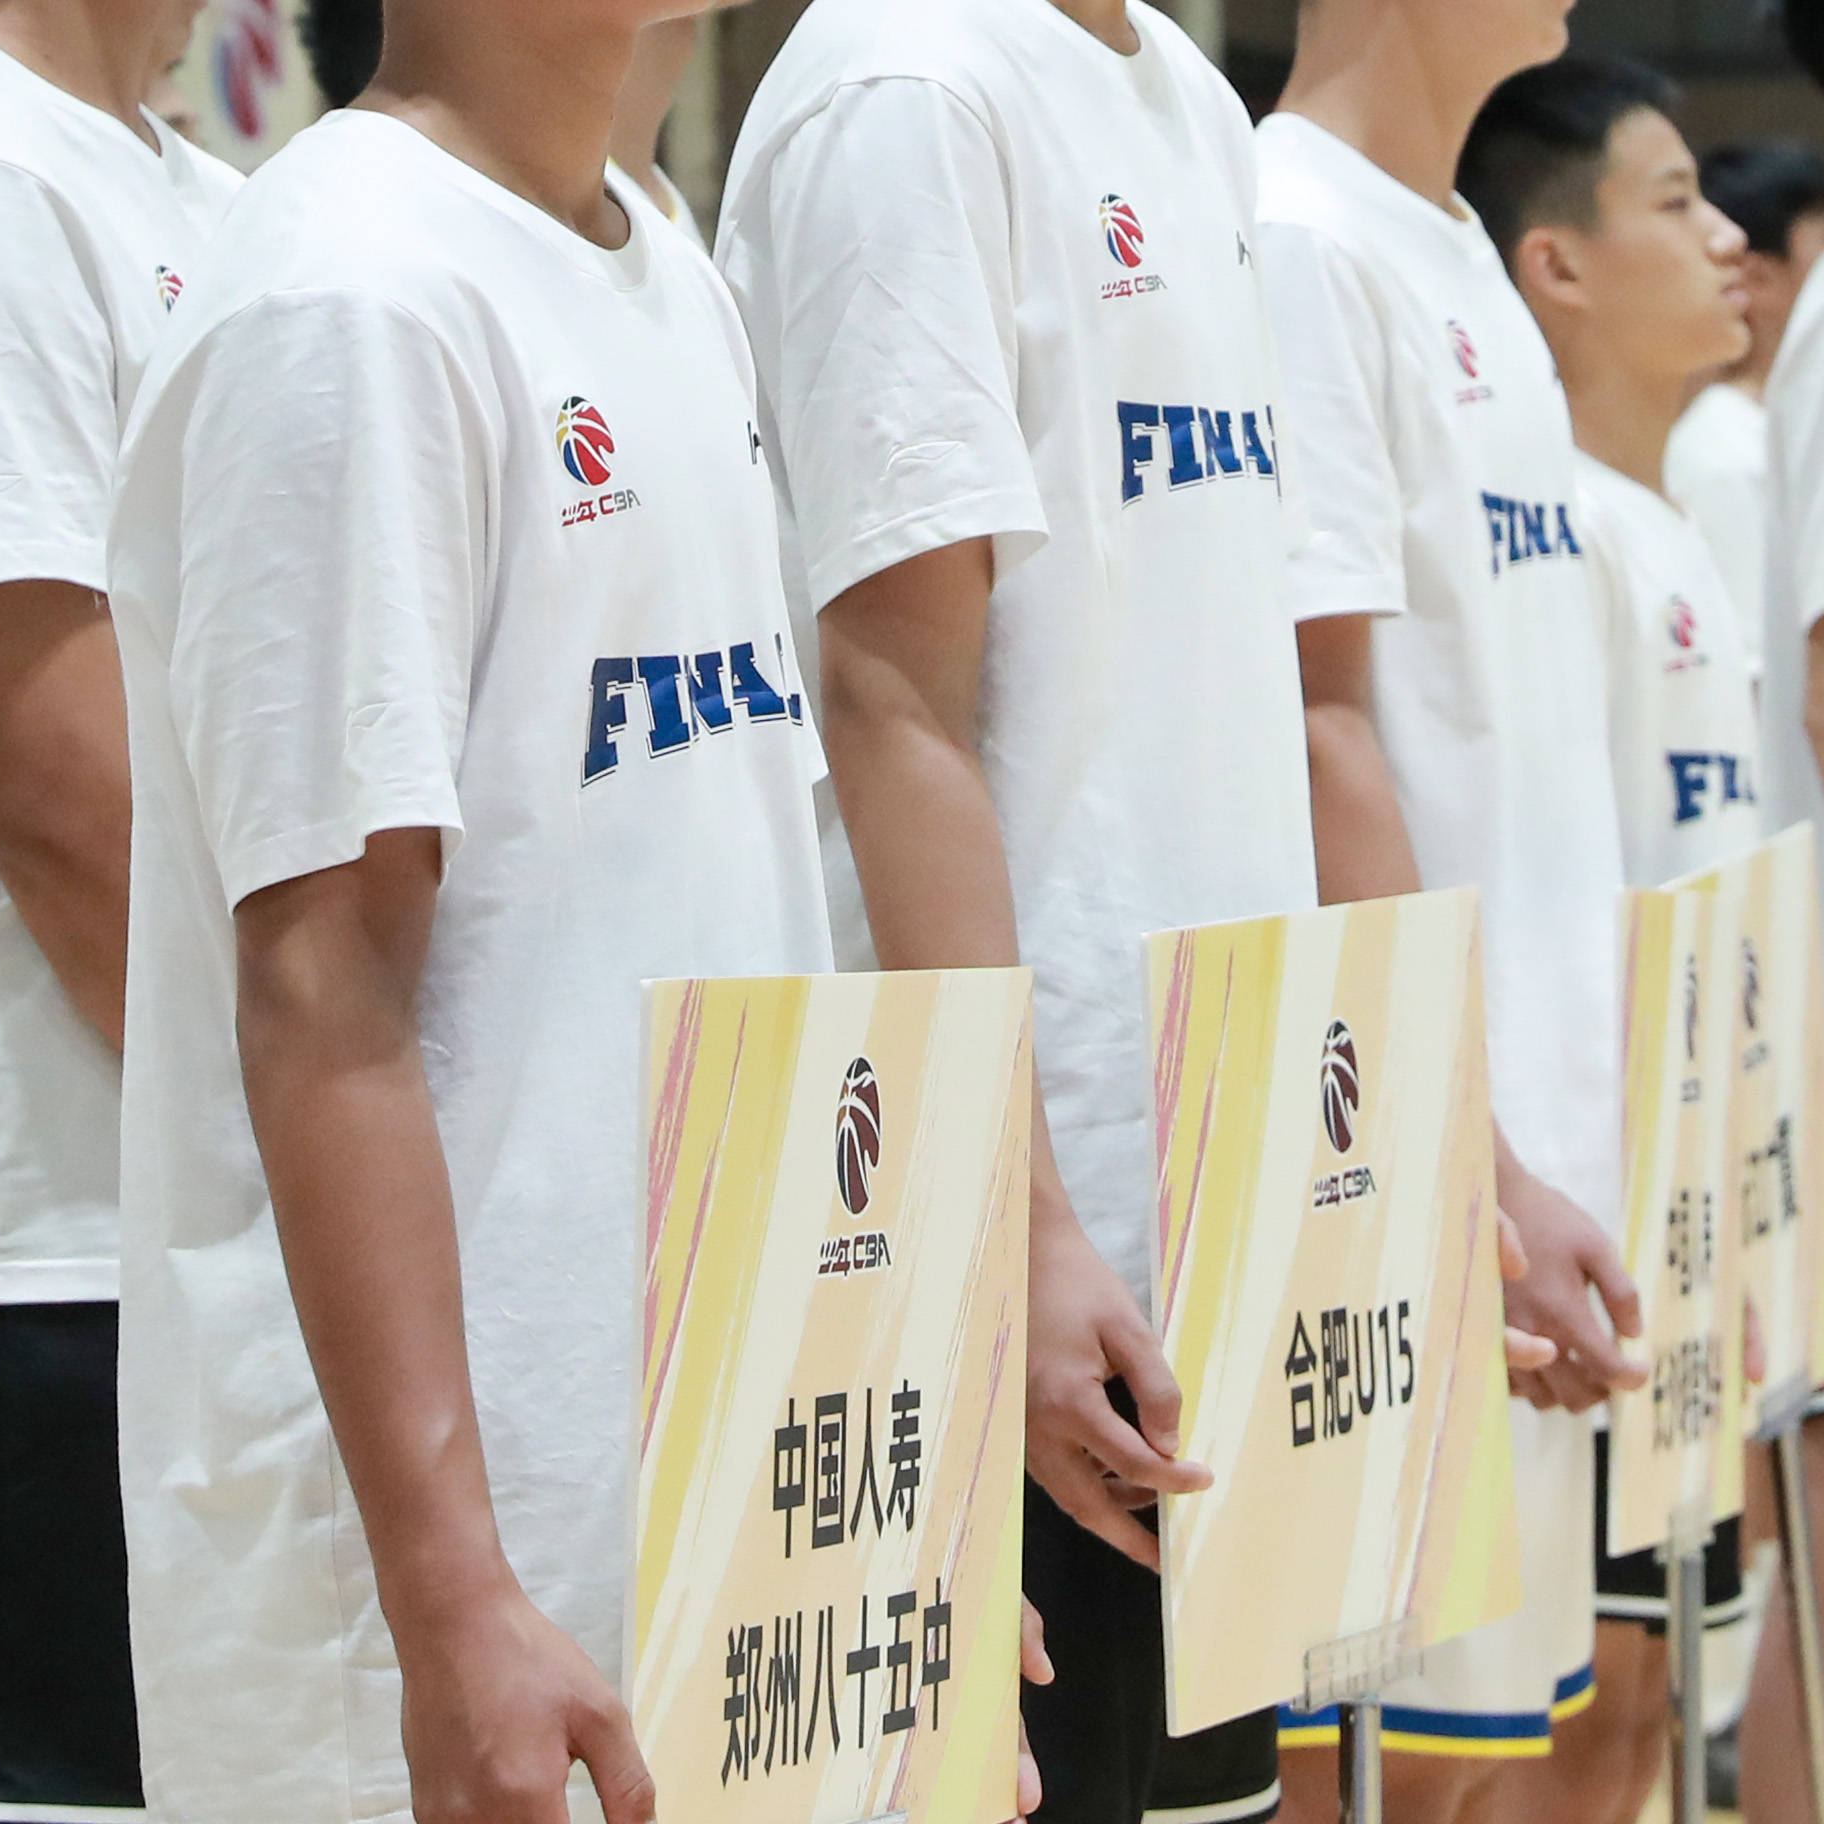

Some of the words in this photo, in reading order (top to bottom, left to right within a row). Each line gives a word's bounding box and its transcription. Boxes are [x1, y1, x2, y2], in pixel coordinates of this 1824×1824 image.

[1284, 1299, 1414, 1448] 合肥U15
[772, 1378, 922, 1559] 中国人寿
[720, 1576, 952, 1789] 郑州八十五中
